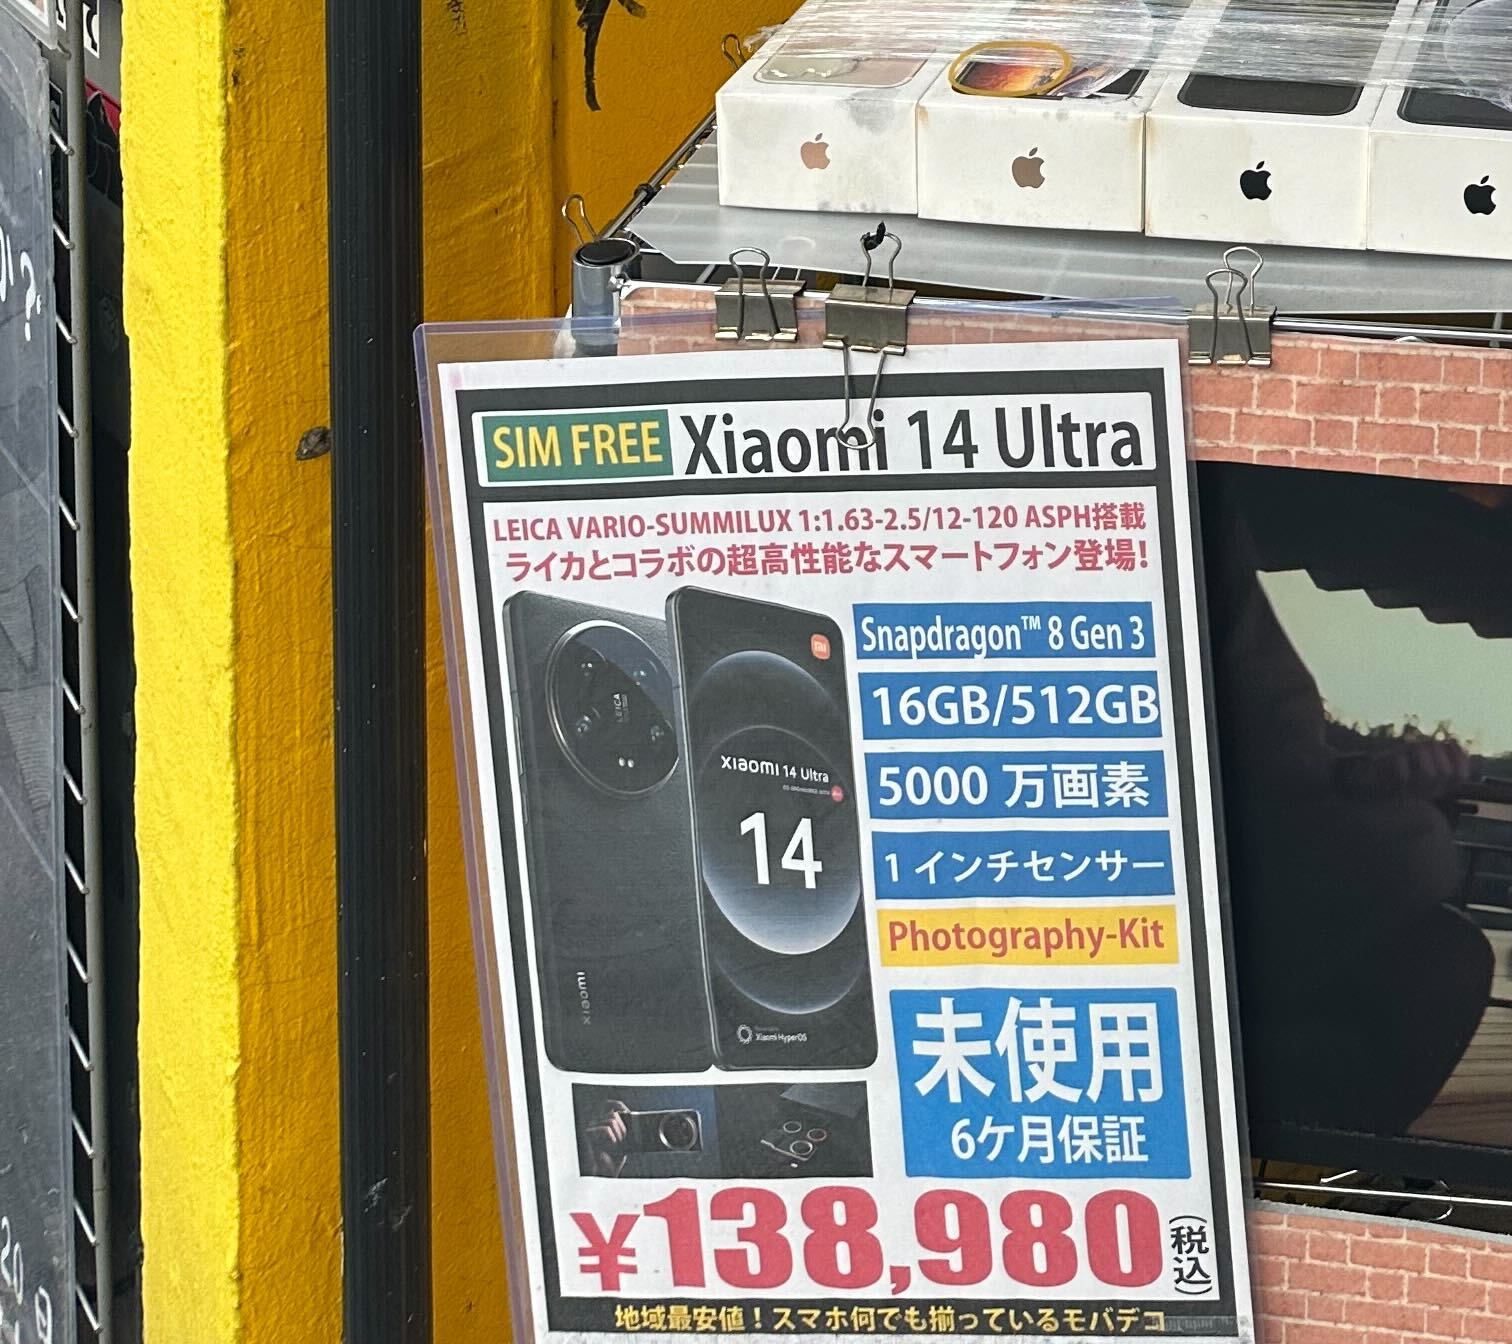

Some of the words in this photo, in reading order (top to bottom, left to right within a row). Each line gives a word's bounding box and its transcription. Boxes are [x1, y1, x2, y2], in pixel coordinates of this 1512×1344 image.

[493, 424, 561, 469] SIM
[571, 421, 663, 465] FREE
[680, 409, 887, 475] Xiaomi
[908, 409, 978, 467] 14
[996, 406, 1143, 470] Ultra
[494, 514, 561, 543] LEICA
[566, 509, 792, 538] VARIO-SUMMILUX
[801, 505, 1018, 535] 1:1.63-2.5/12-120
[1025, 501, 1146, 533] ASPH搭載
[1047, 619, 1064, 647] 8
[1070, 617, 1122, 648] Gen
[1131, 616, 1146, 644] 3
[873, 683, 1160, 729] 16GB/512GB
[782, 764, 797, 778] 14
[800, 767, 830, 783] Ultra
[879, 765, 988, 806] 5000
[1003, 762, 1150, 810] 万画素
[740, 813, 823, 889] 14
[885, 855, 898, 883] 1
[915, 849, 1165, 885] インチセンサー
[888, 919, 1164, 958] Photography-Kit
[913, 998, 1162, 1105] 未使用
[570, 1187, 1163, 1293] ¥138,980
